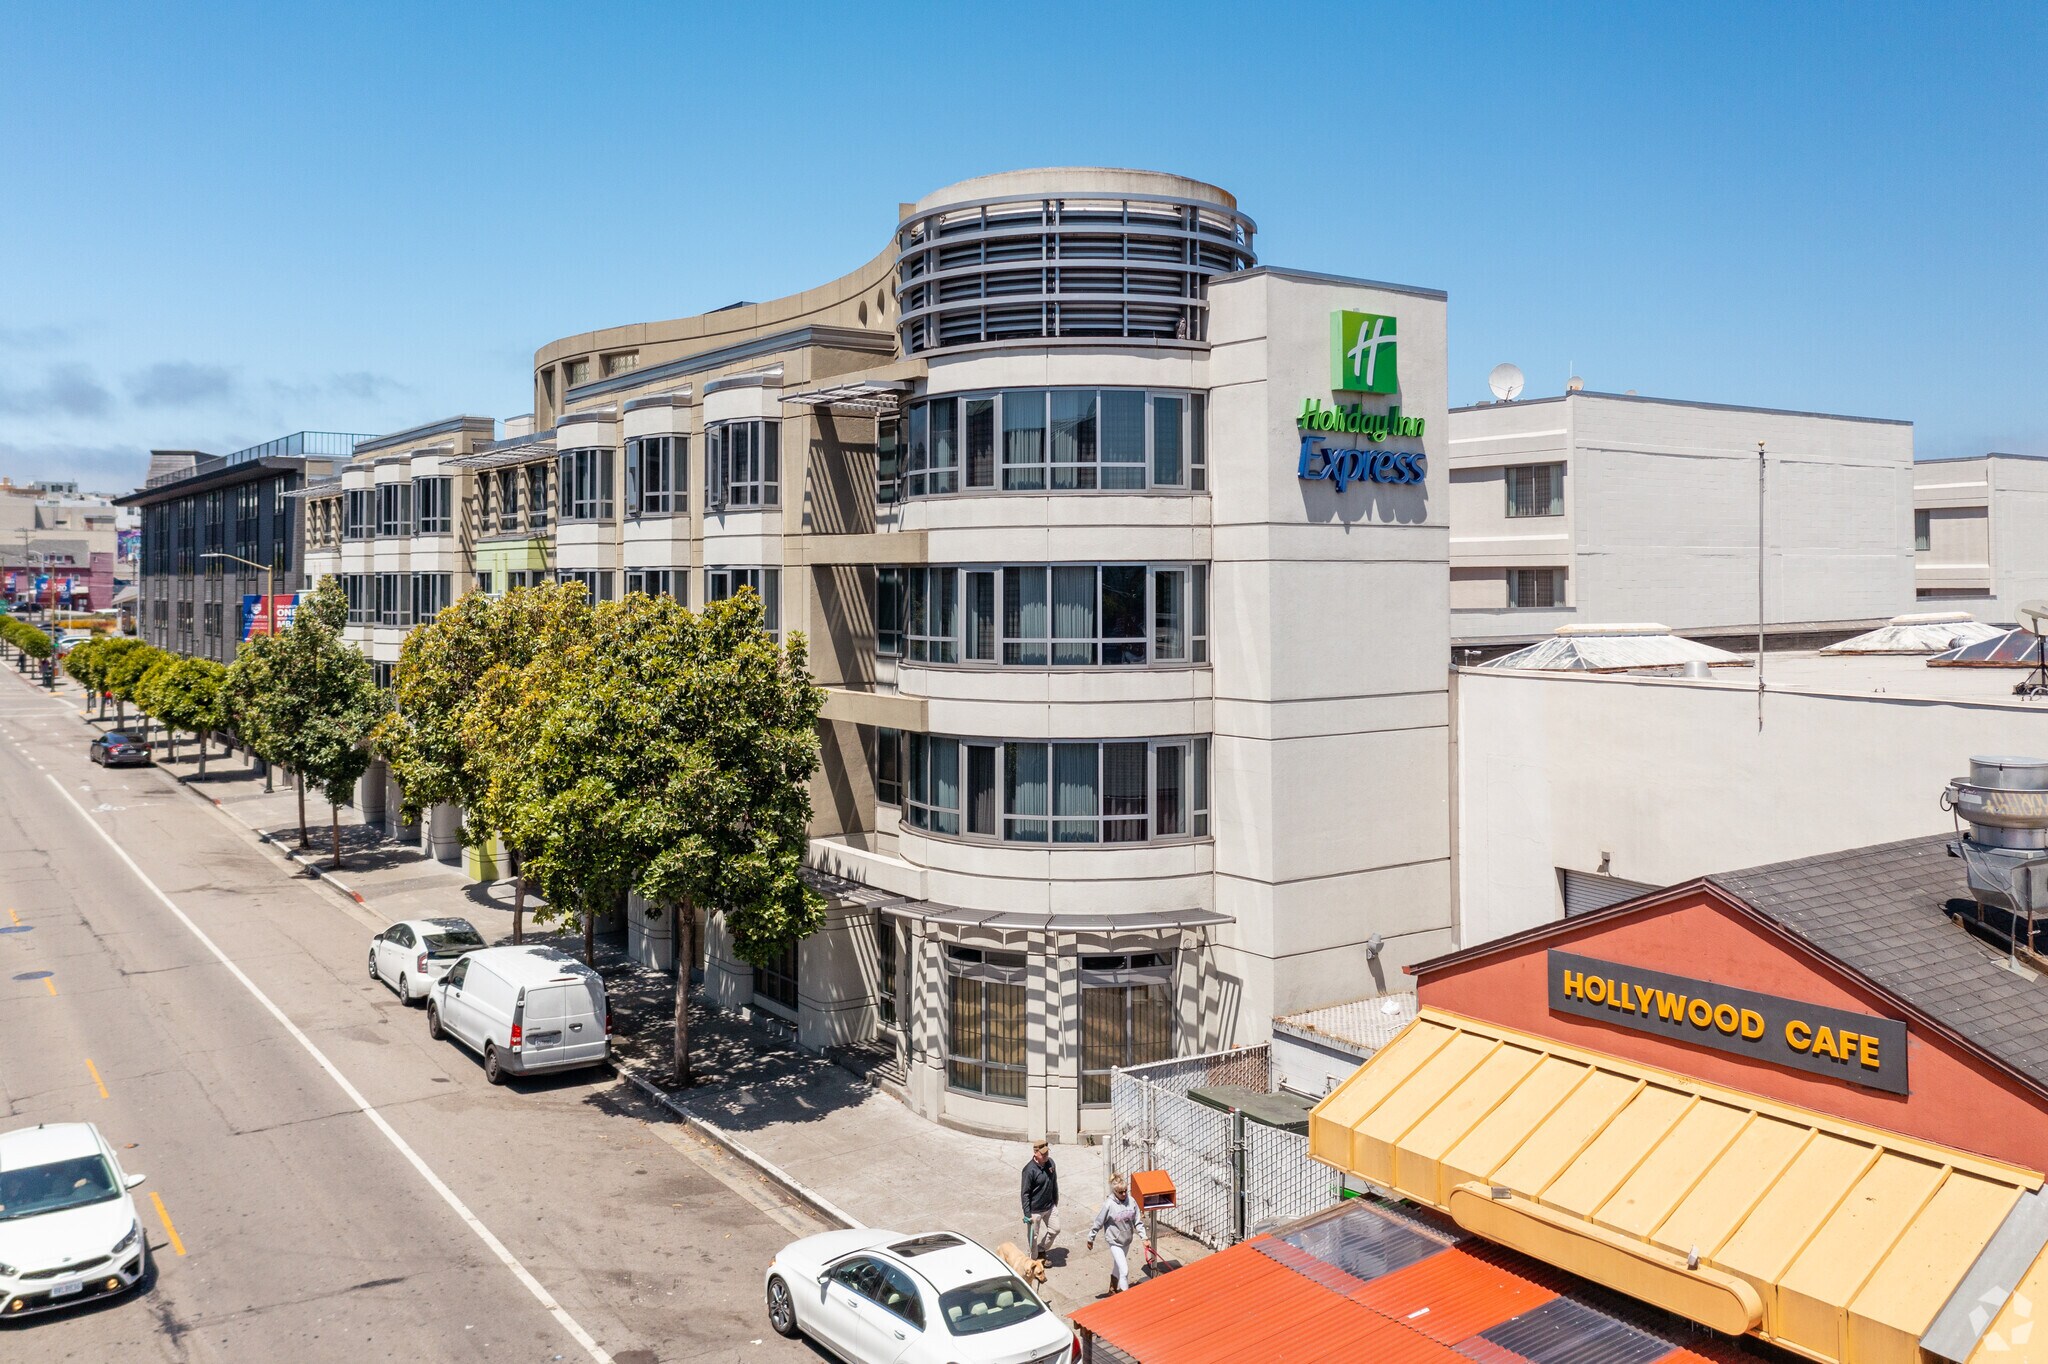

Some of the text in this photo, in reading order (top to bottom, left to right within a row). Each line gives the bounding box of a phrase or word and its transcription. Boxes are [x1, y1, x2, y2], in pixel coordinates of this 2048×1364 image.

[1297, 398, 1426, 442] Holiday Inn
[1297, 435, 1427, 493] Express
[1563, 969, 1880, 1068] HOLLYWOOD CAFE
